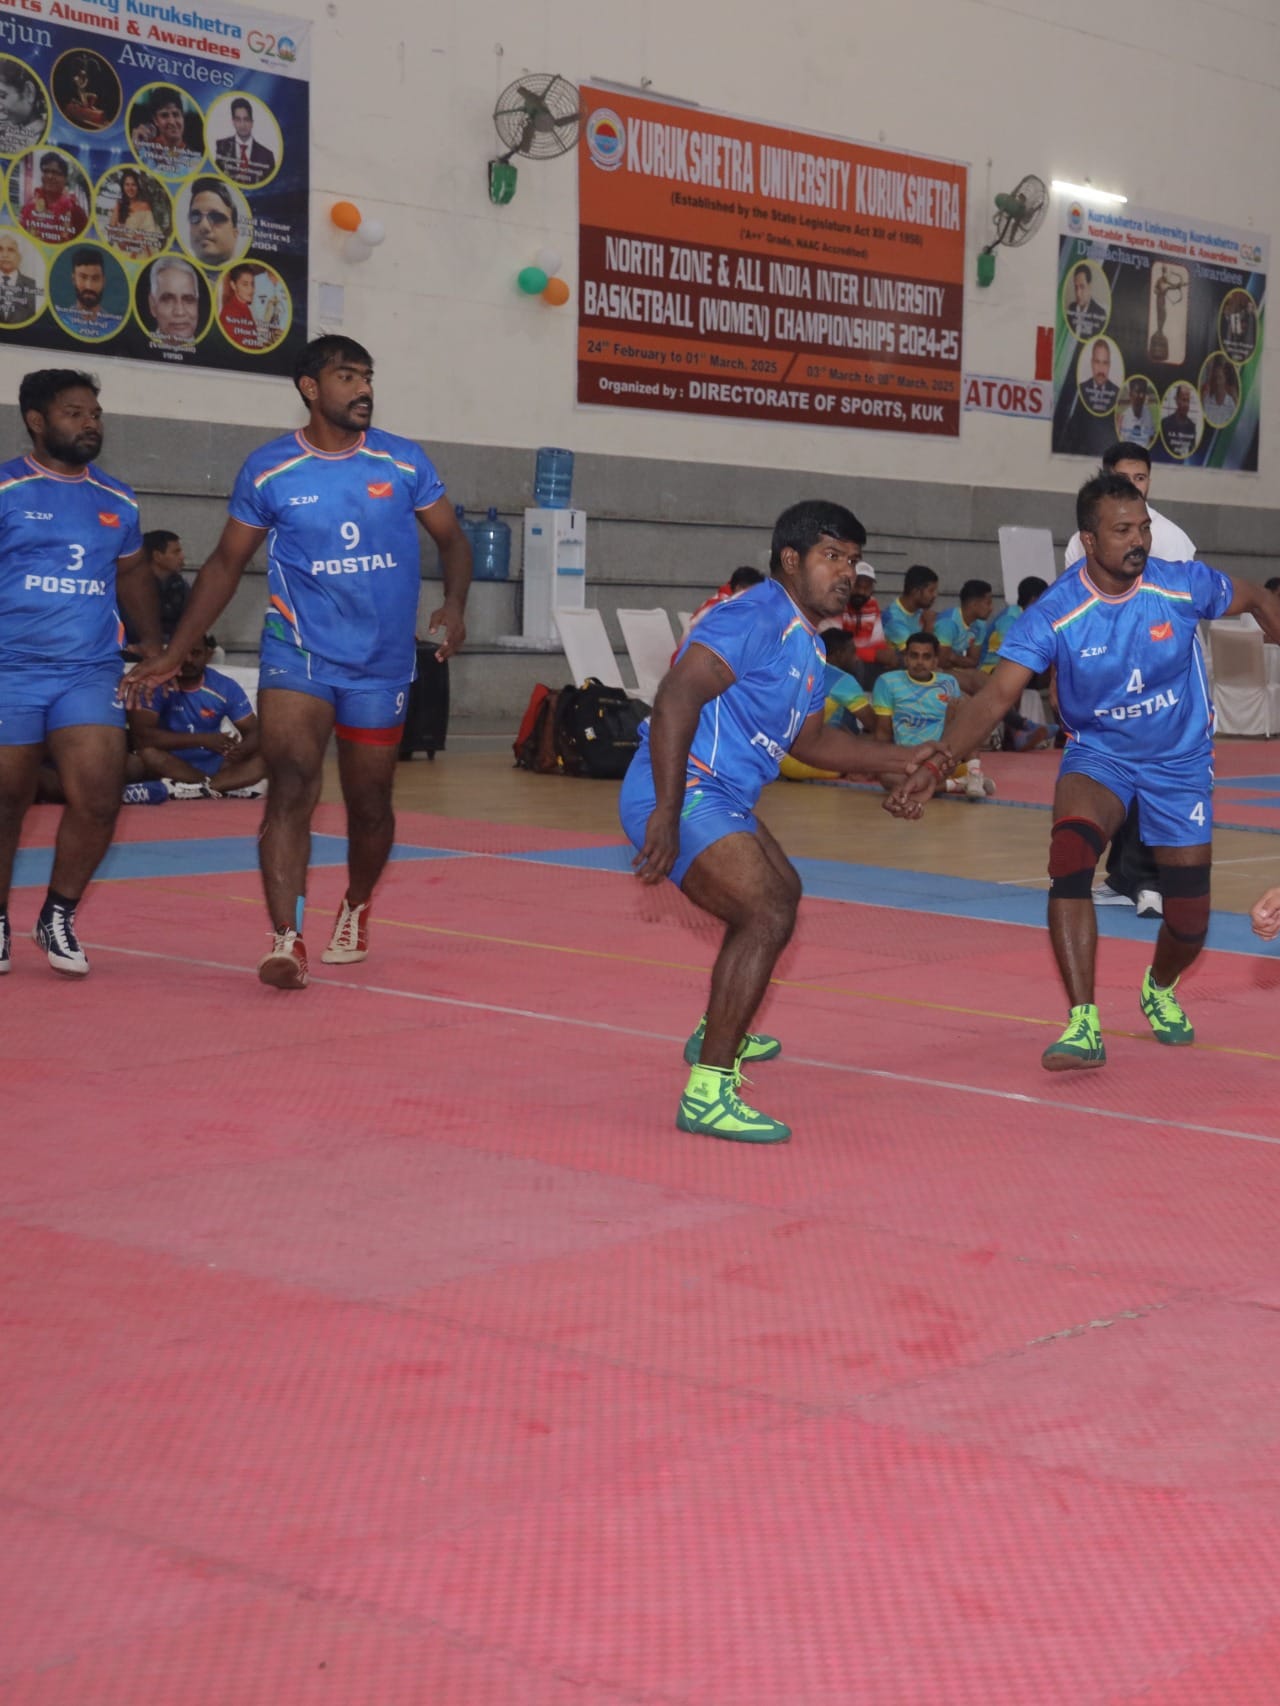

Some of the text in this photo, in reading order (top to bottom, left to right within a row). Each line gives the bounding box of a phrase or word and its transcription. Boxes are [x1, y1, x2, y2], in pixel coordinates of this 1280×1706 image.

[50, 2, 119, 32] Alumni
[127, 20, 140, 37] &
[147, 25, 241, 60] Awardees
[127, 0, 242, 39] Kurukshetra
[0, 18, 236, 88] rjun Awardees
[627, 117, 961, 232] KURUKSHETRA UNIVERSITY KURUKSHETRA
[671, 192, 735, 215] (Established
[737, 204, 750, 219] by
[752, 206, 769, 220] the
[771, 208, 797, 225] State
[799, 213, 851, 235] Legislature
[854, 223, 870, 238] Act
[887, 228, 898, 241] of
[605, 236, 945, 318] NORTH ZONE & ALL INDIA INTER UNIVERSITY
[584, 280, 959, 361] BASKETBALL (WOMEN) CHAMPIONSHIPS 2024-25
[614, 344, 666, 364] February
[670, 352, 682, 363] to
[751, 359, 777, 373] 2025
[829, 368, 862, 381] March
[864, 372, 874, 383] to
[598, 377, 660, 397] Organized
[663, 384, 679, 400] by
[689, 381, 810, 410] DIRECTORATE
[814, 393, 836, 412] OF
[840, 396, 907, 421] SPORTS,
[911, 403, 944, 422] KUK
[964, 379, 1043, 414] ATORS
[36, 512, 54, 521] ZAP
[340, 521, 361, 551] 9
[66, 543, 85, 571] 3
[311, 552, 397, 576] POSTAL
[1126, 668, 1145, 694] 4
[394, 691, 406, 715] 9
[1189, 801, 1206, 827] 4
